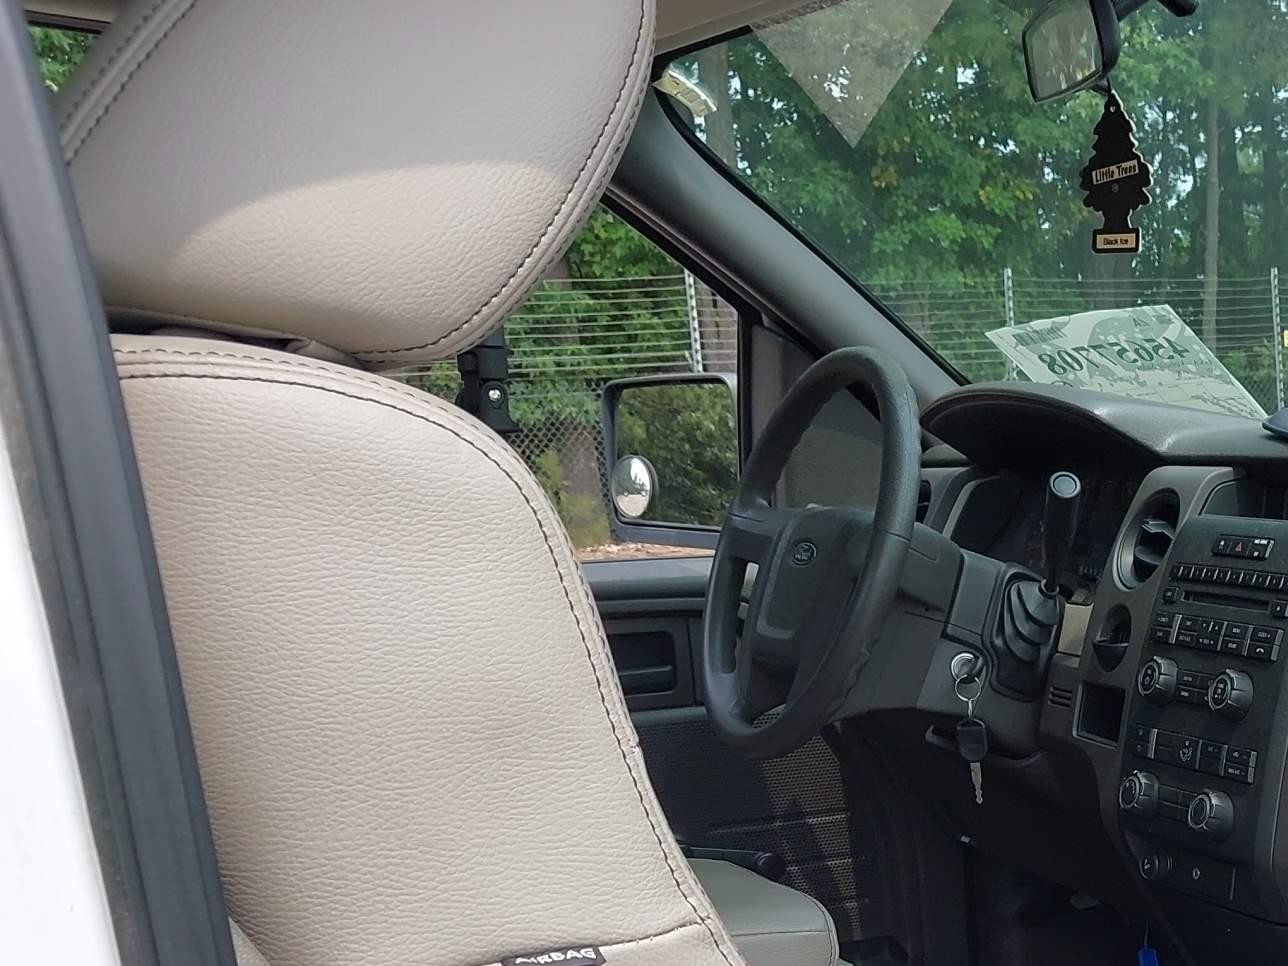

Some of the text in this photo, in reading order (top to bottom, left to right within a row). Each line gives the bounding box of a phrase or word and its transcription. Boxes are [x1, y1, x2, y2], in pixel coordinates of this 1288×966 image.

[1094, 164, 1137, 183] Little Trees
[1103, 238, 1119, 246] Black
